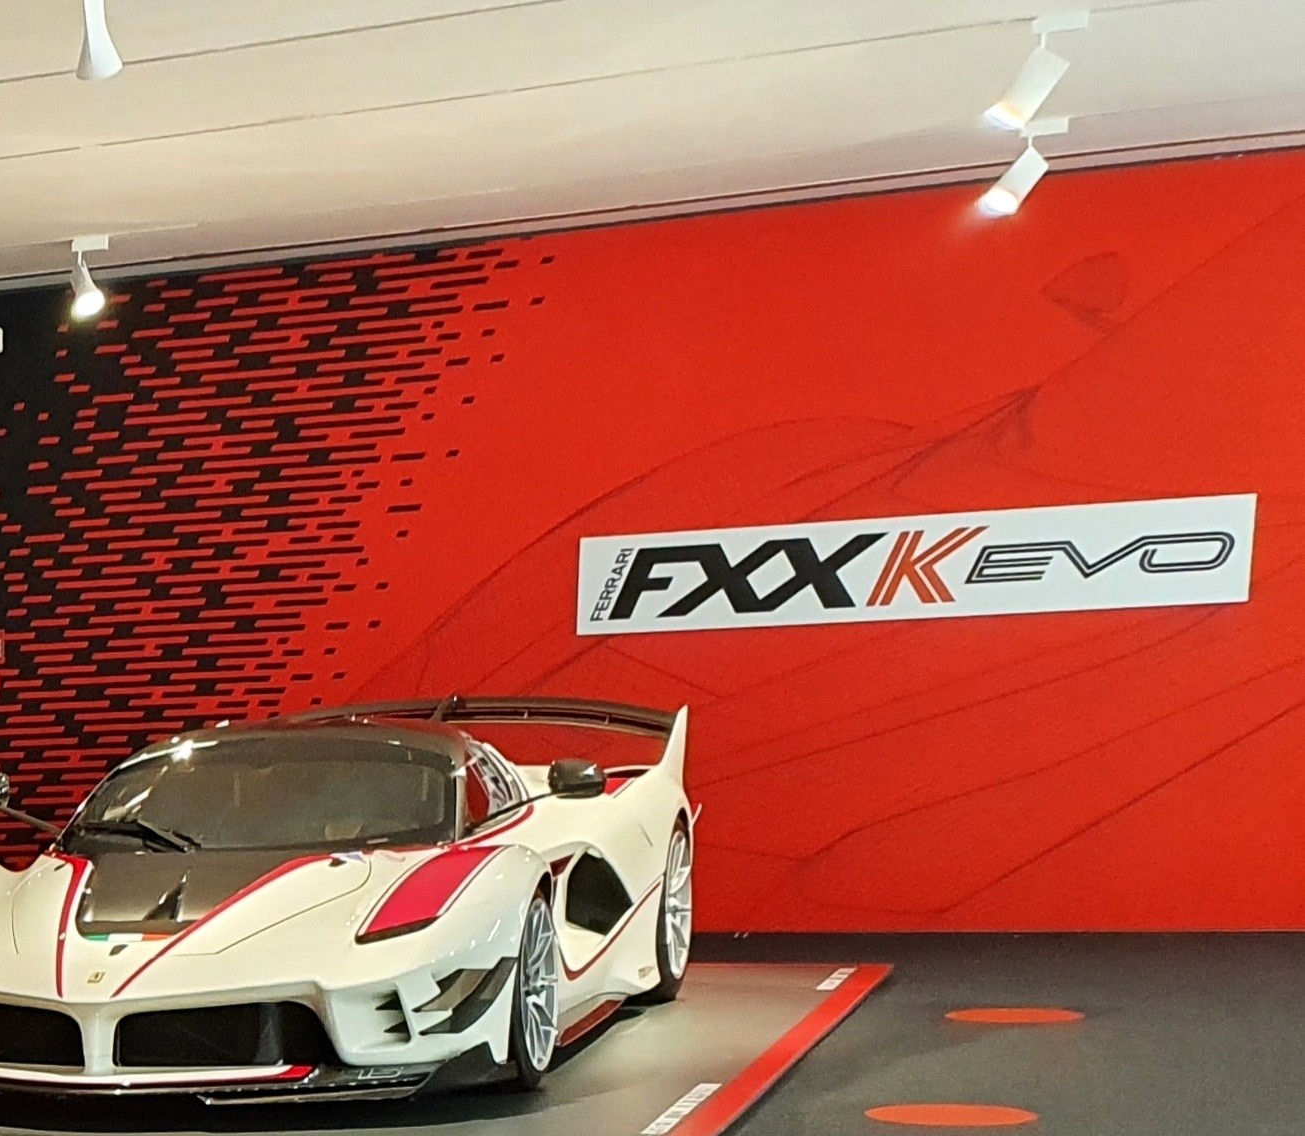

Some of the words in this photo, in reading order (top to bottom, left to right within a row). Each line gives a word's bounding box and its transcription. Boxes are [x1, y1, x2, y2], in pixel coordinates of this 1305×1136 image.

[589, 547, 634, 622] FERRARI
[607, 532, 889, 619] FXX
[865, 525, 990, 606] K
[964, 531, 1235, 584] EVO
